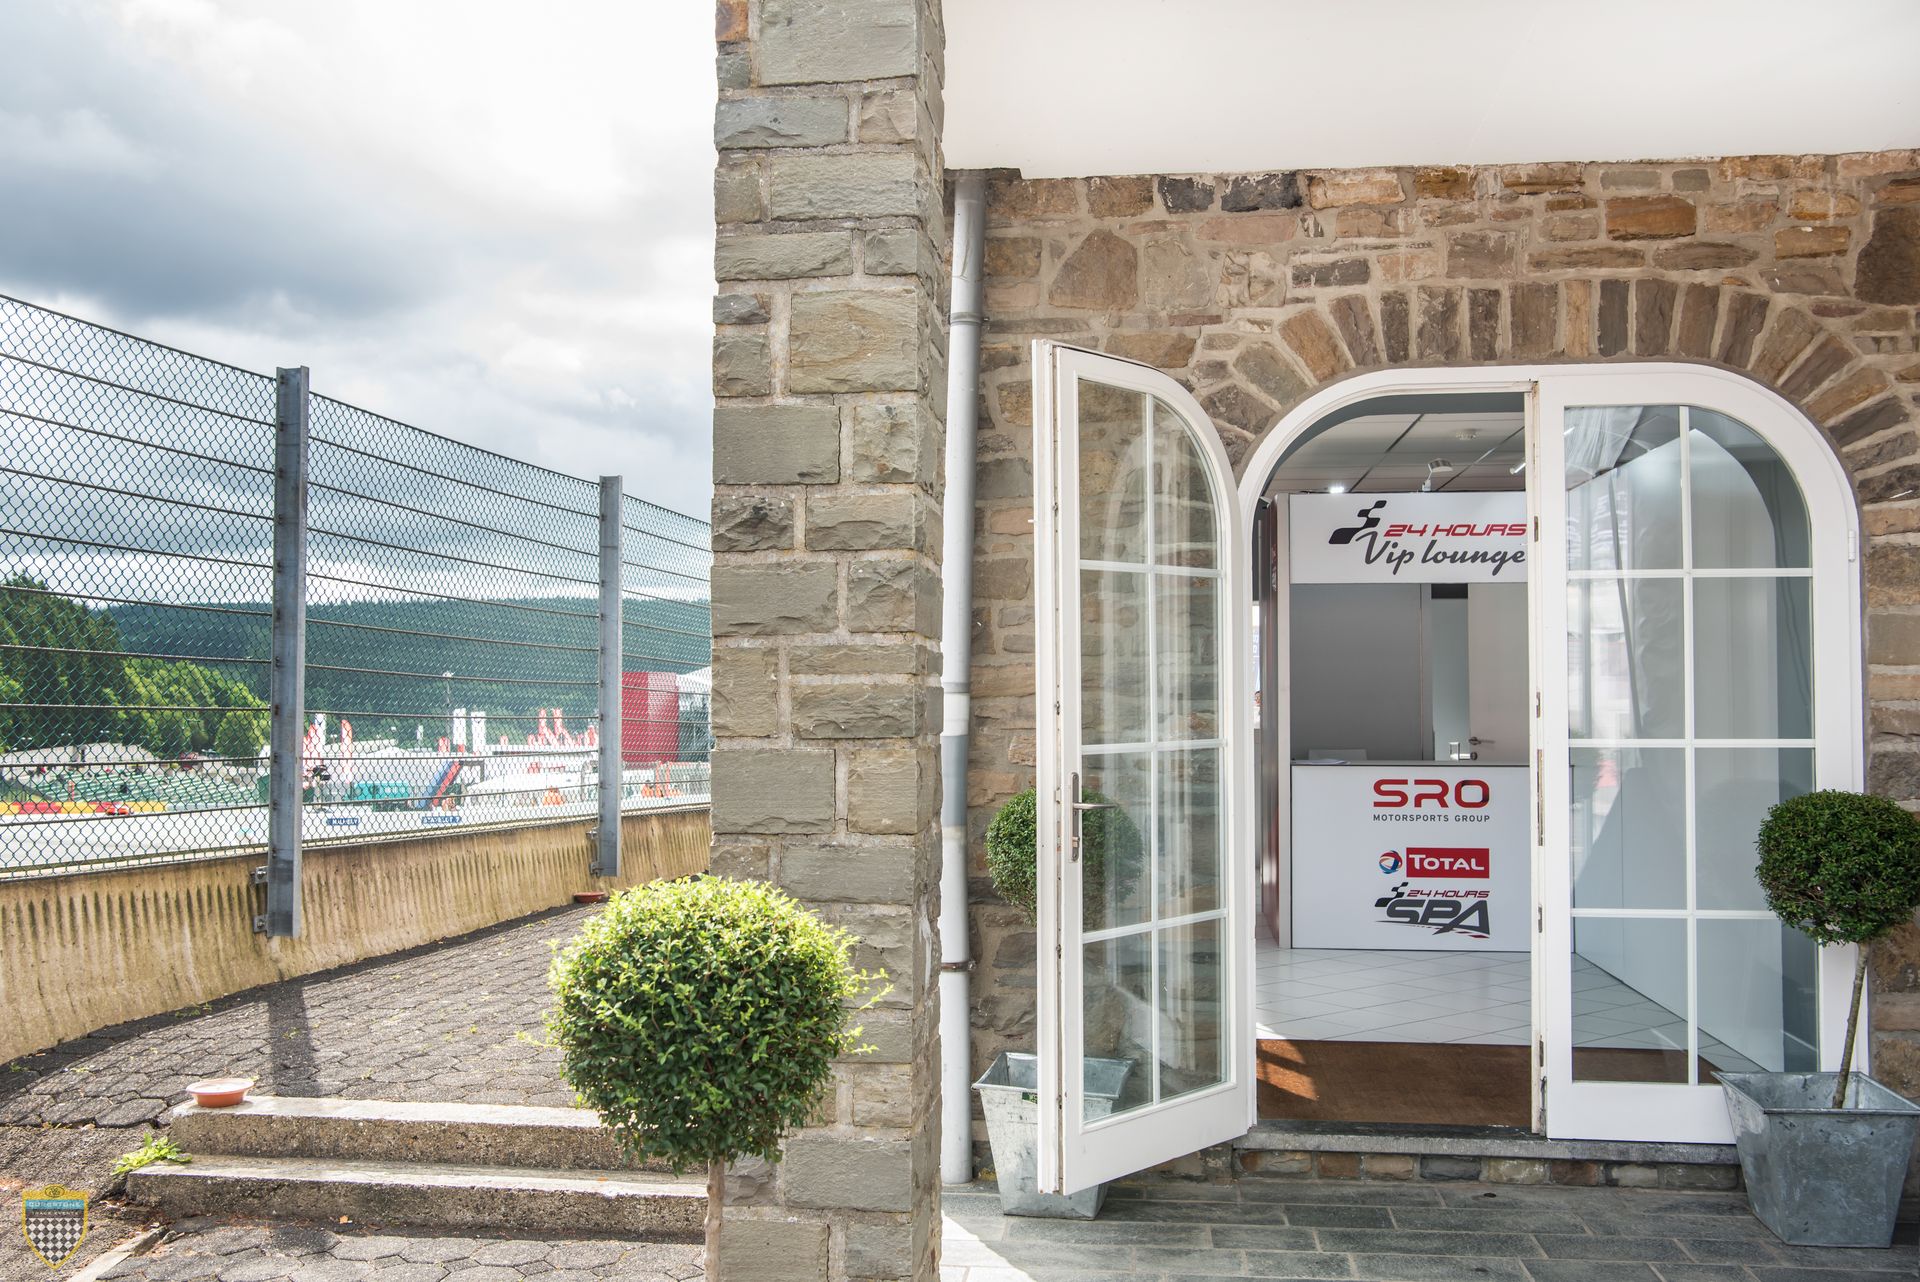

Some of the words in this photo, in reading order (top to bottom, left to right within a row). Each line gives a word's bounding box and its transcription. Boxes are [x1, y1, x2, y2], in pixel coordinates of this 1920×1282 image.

[1383, 524, 1427, 538] 24
[1431, 523, 1528, 537] HOURS
[1355, 530, 1415, 576] Vip
[1420, 539, 1526, 577] lounge
[1373, 778, 1490, 809] SRO
[1373, 813, 1449, 823] MOTORSPORTS
[1454, 814, 1491, 823] GROUP
[1408, 853, 1485, 871] TOTAL
[1407, 889, 1432, 898] 24
[1433, 889, 1491, 899] HOURS
[1385, 898, 1491, 936] SPA
